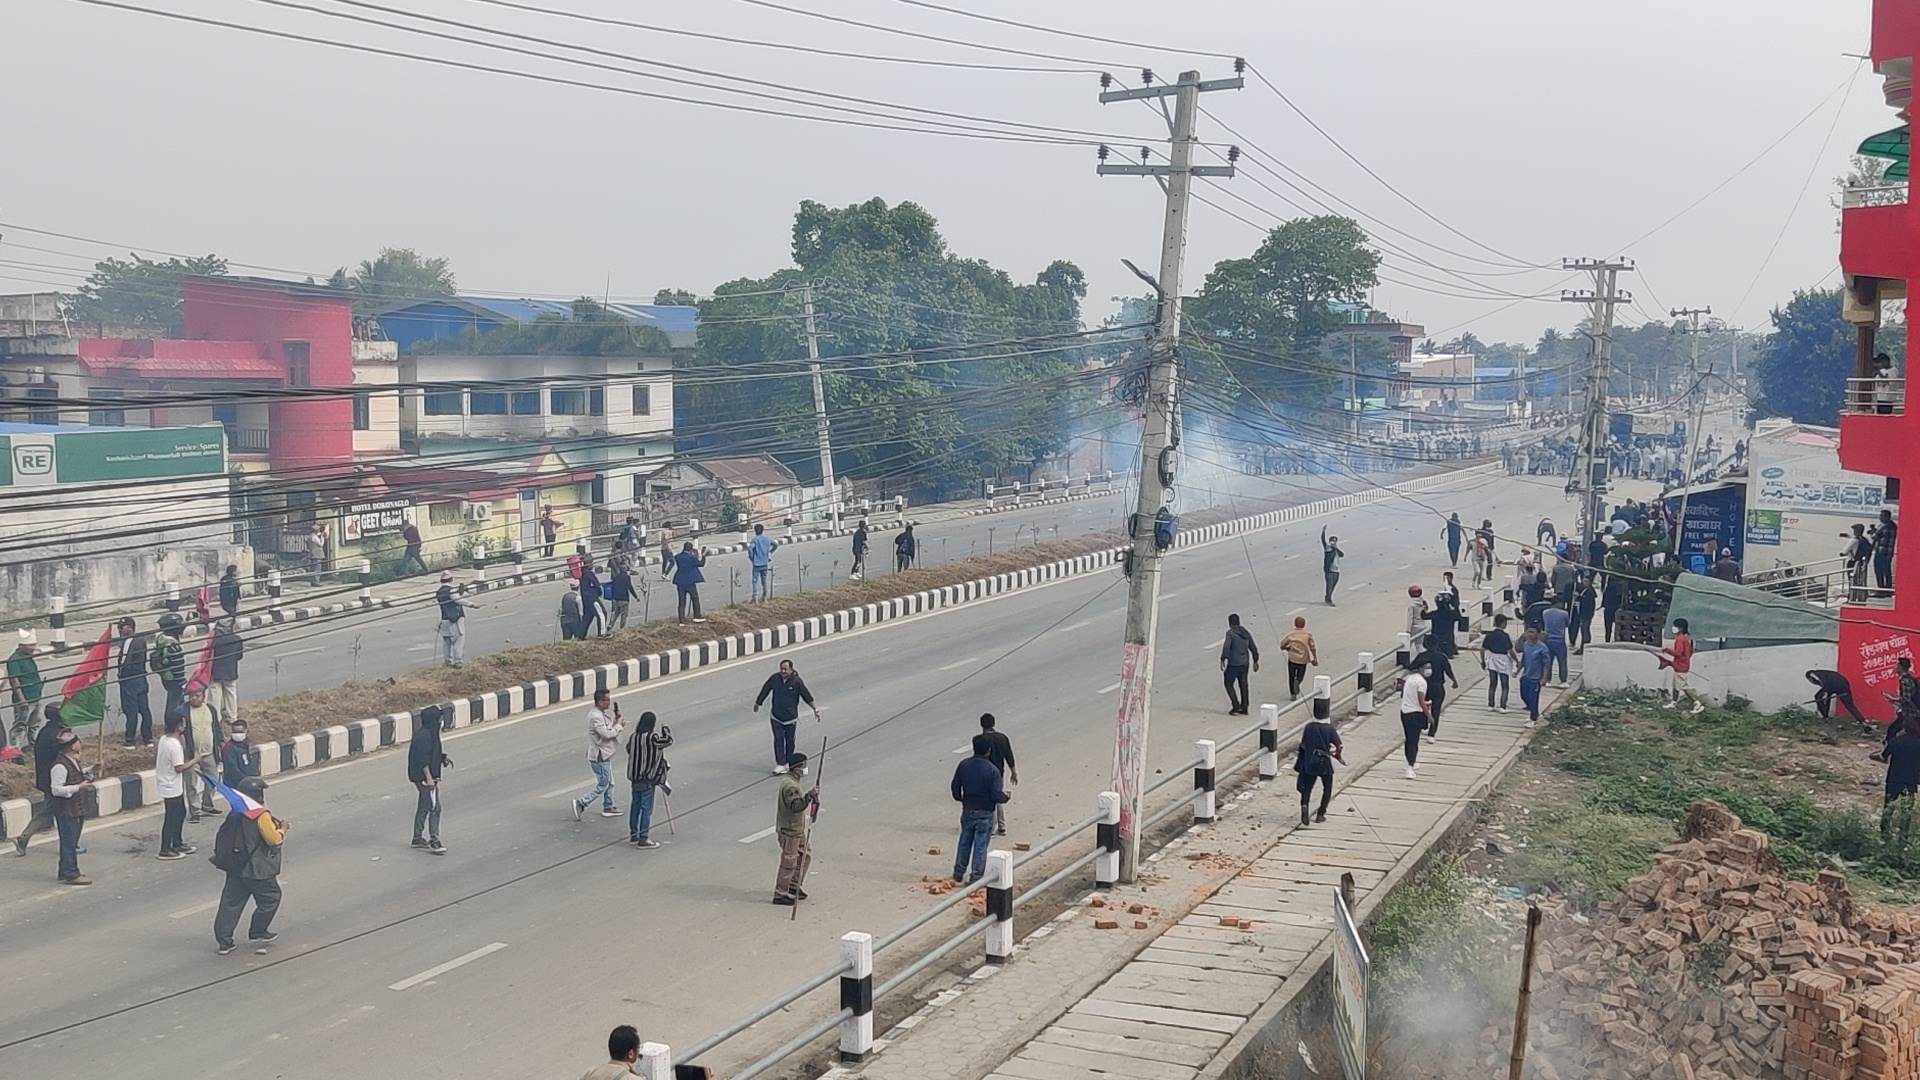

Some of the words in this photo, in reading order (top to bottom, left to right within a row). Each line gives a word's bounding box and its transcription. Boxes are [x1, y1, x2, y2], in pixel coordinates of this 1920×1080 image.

[22, 455, 46, 468] RE
[351, 503, 371, 512] HOTEL
[361, 512, 379, 529] GEET
[1728, 503, 1737, 547] HOTE
